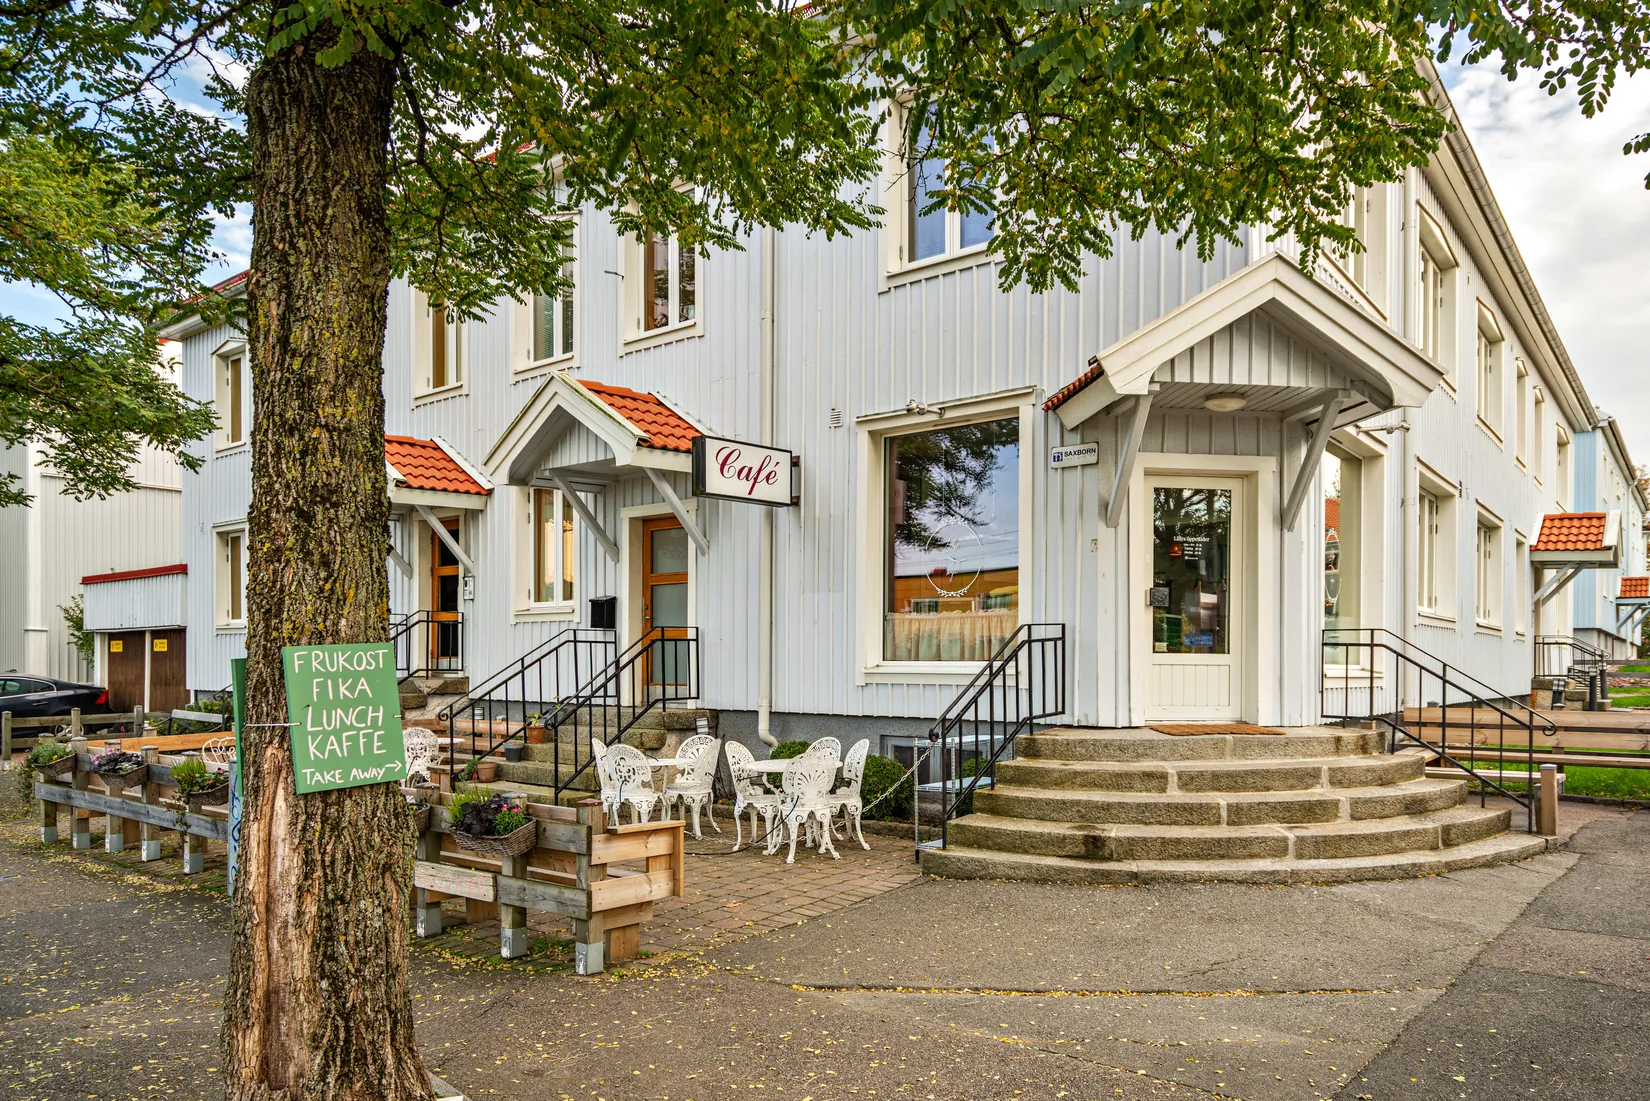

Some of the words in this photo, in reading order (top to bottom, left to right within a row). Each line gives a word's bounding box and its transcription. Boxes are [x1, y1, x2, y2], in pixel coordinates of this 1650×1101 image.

[1064, 447, 1097, 458] SAXBORN
[715, 446, 780, 496] Café
[293, 650, 388, 673] FRUKOST
[312, 677, 373, 702] FIKA
[306, 705, 384, 732] LUNCH
[308, 729, 387, 761] KAFFE
[302, 768, 345, 785] TAKE
[349, 766, 386, 781] AWAY
